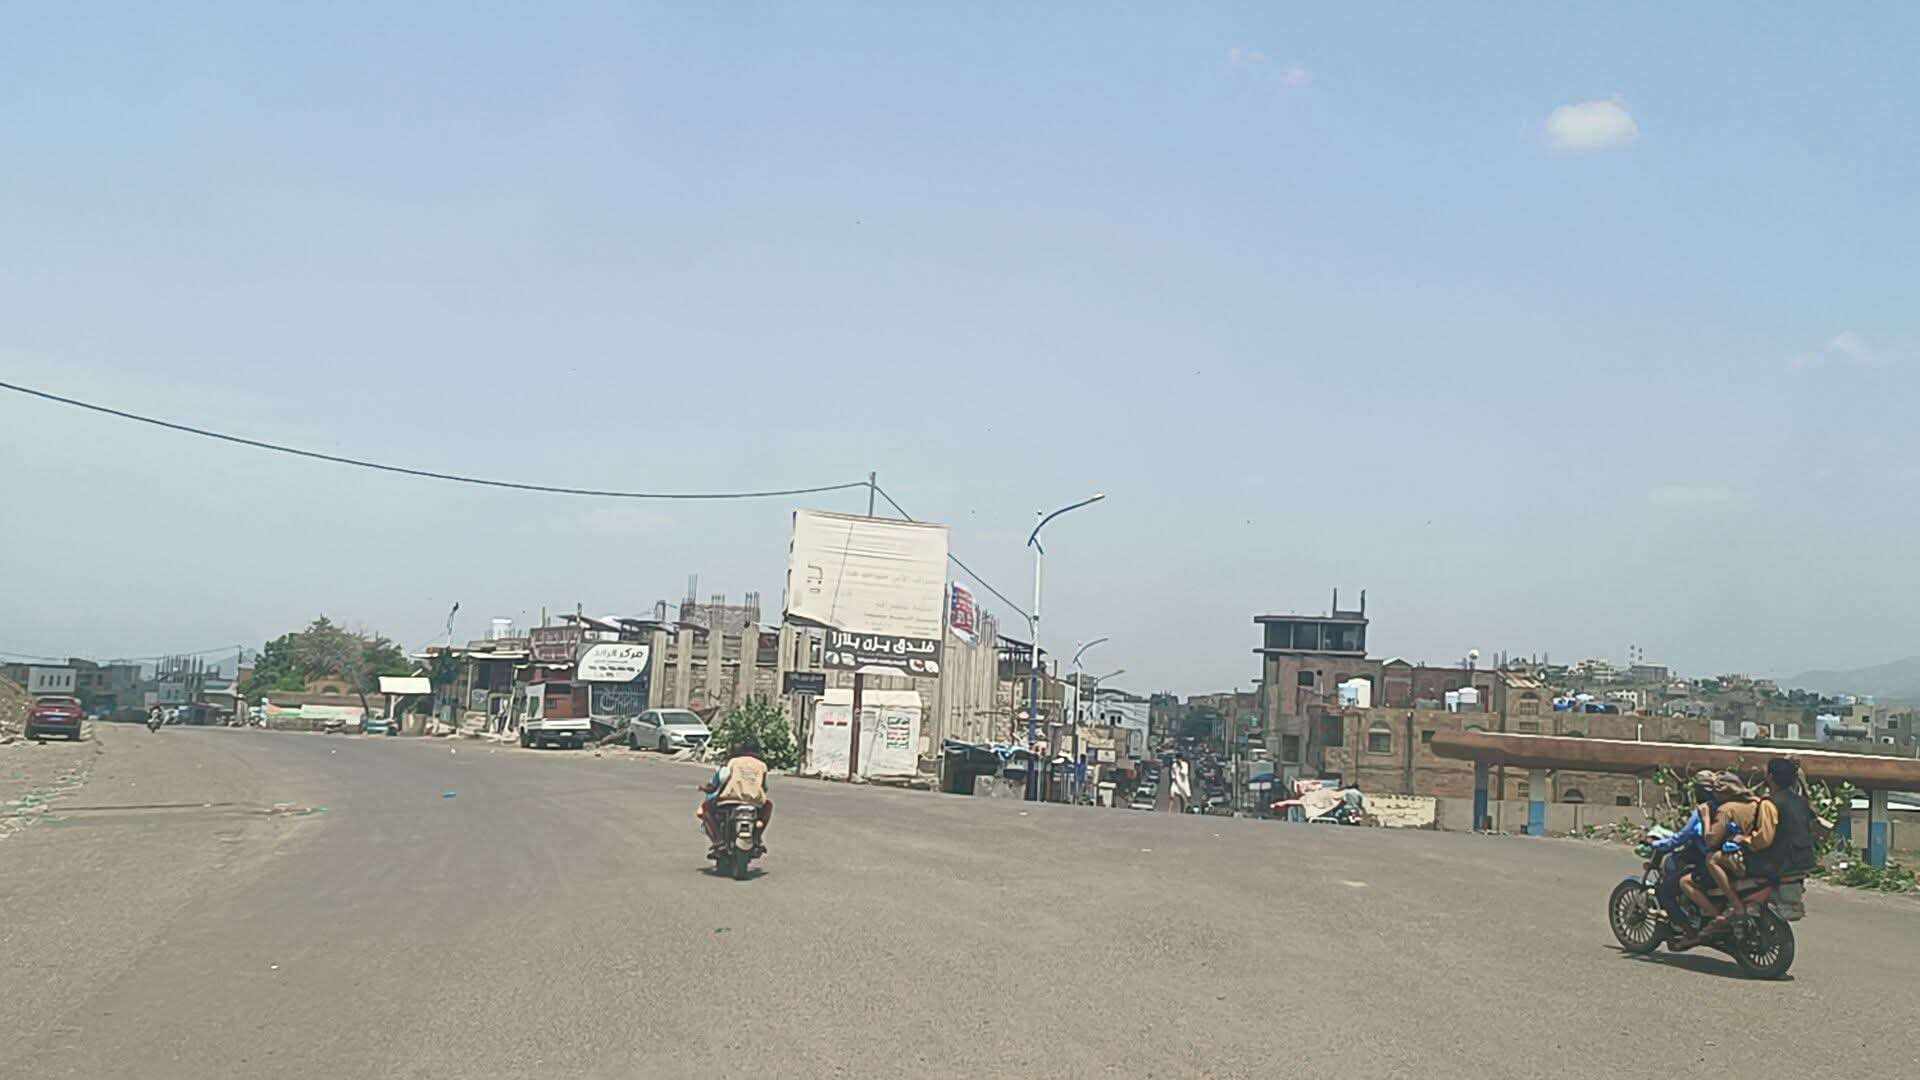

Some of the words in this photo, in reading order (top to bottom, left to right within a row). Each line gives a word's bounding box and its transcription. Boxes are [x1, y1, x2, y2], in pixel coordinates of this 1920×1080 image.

[832, 631, 860, 649] بلازا
[893, 639, 935, 654] فندق
[619, 648, 644, 659] مركز
